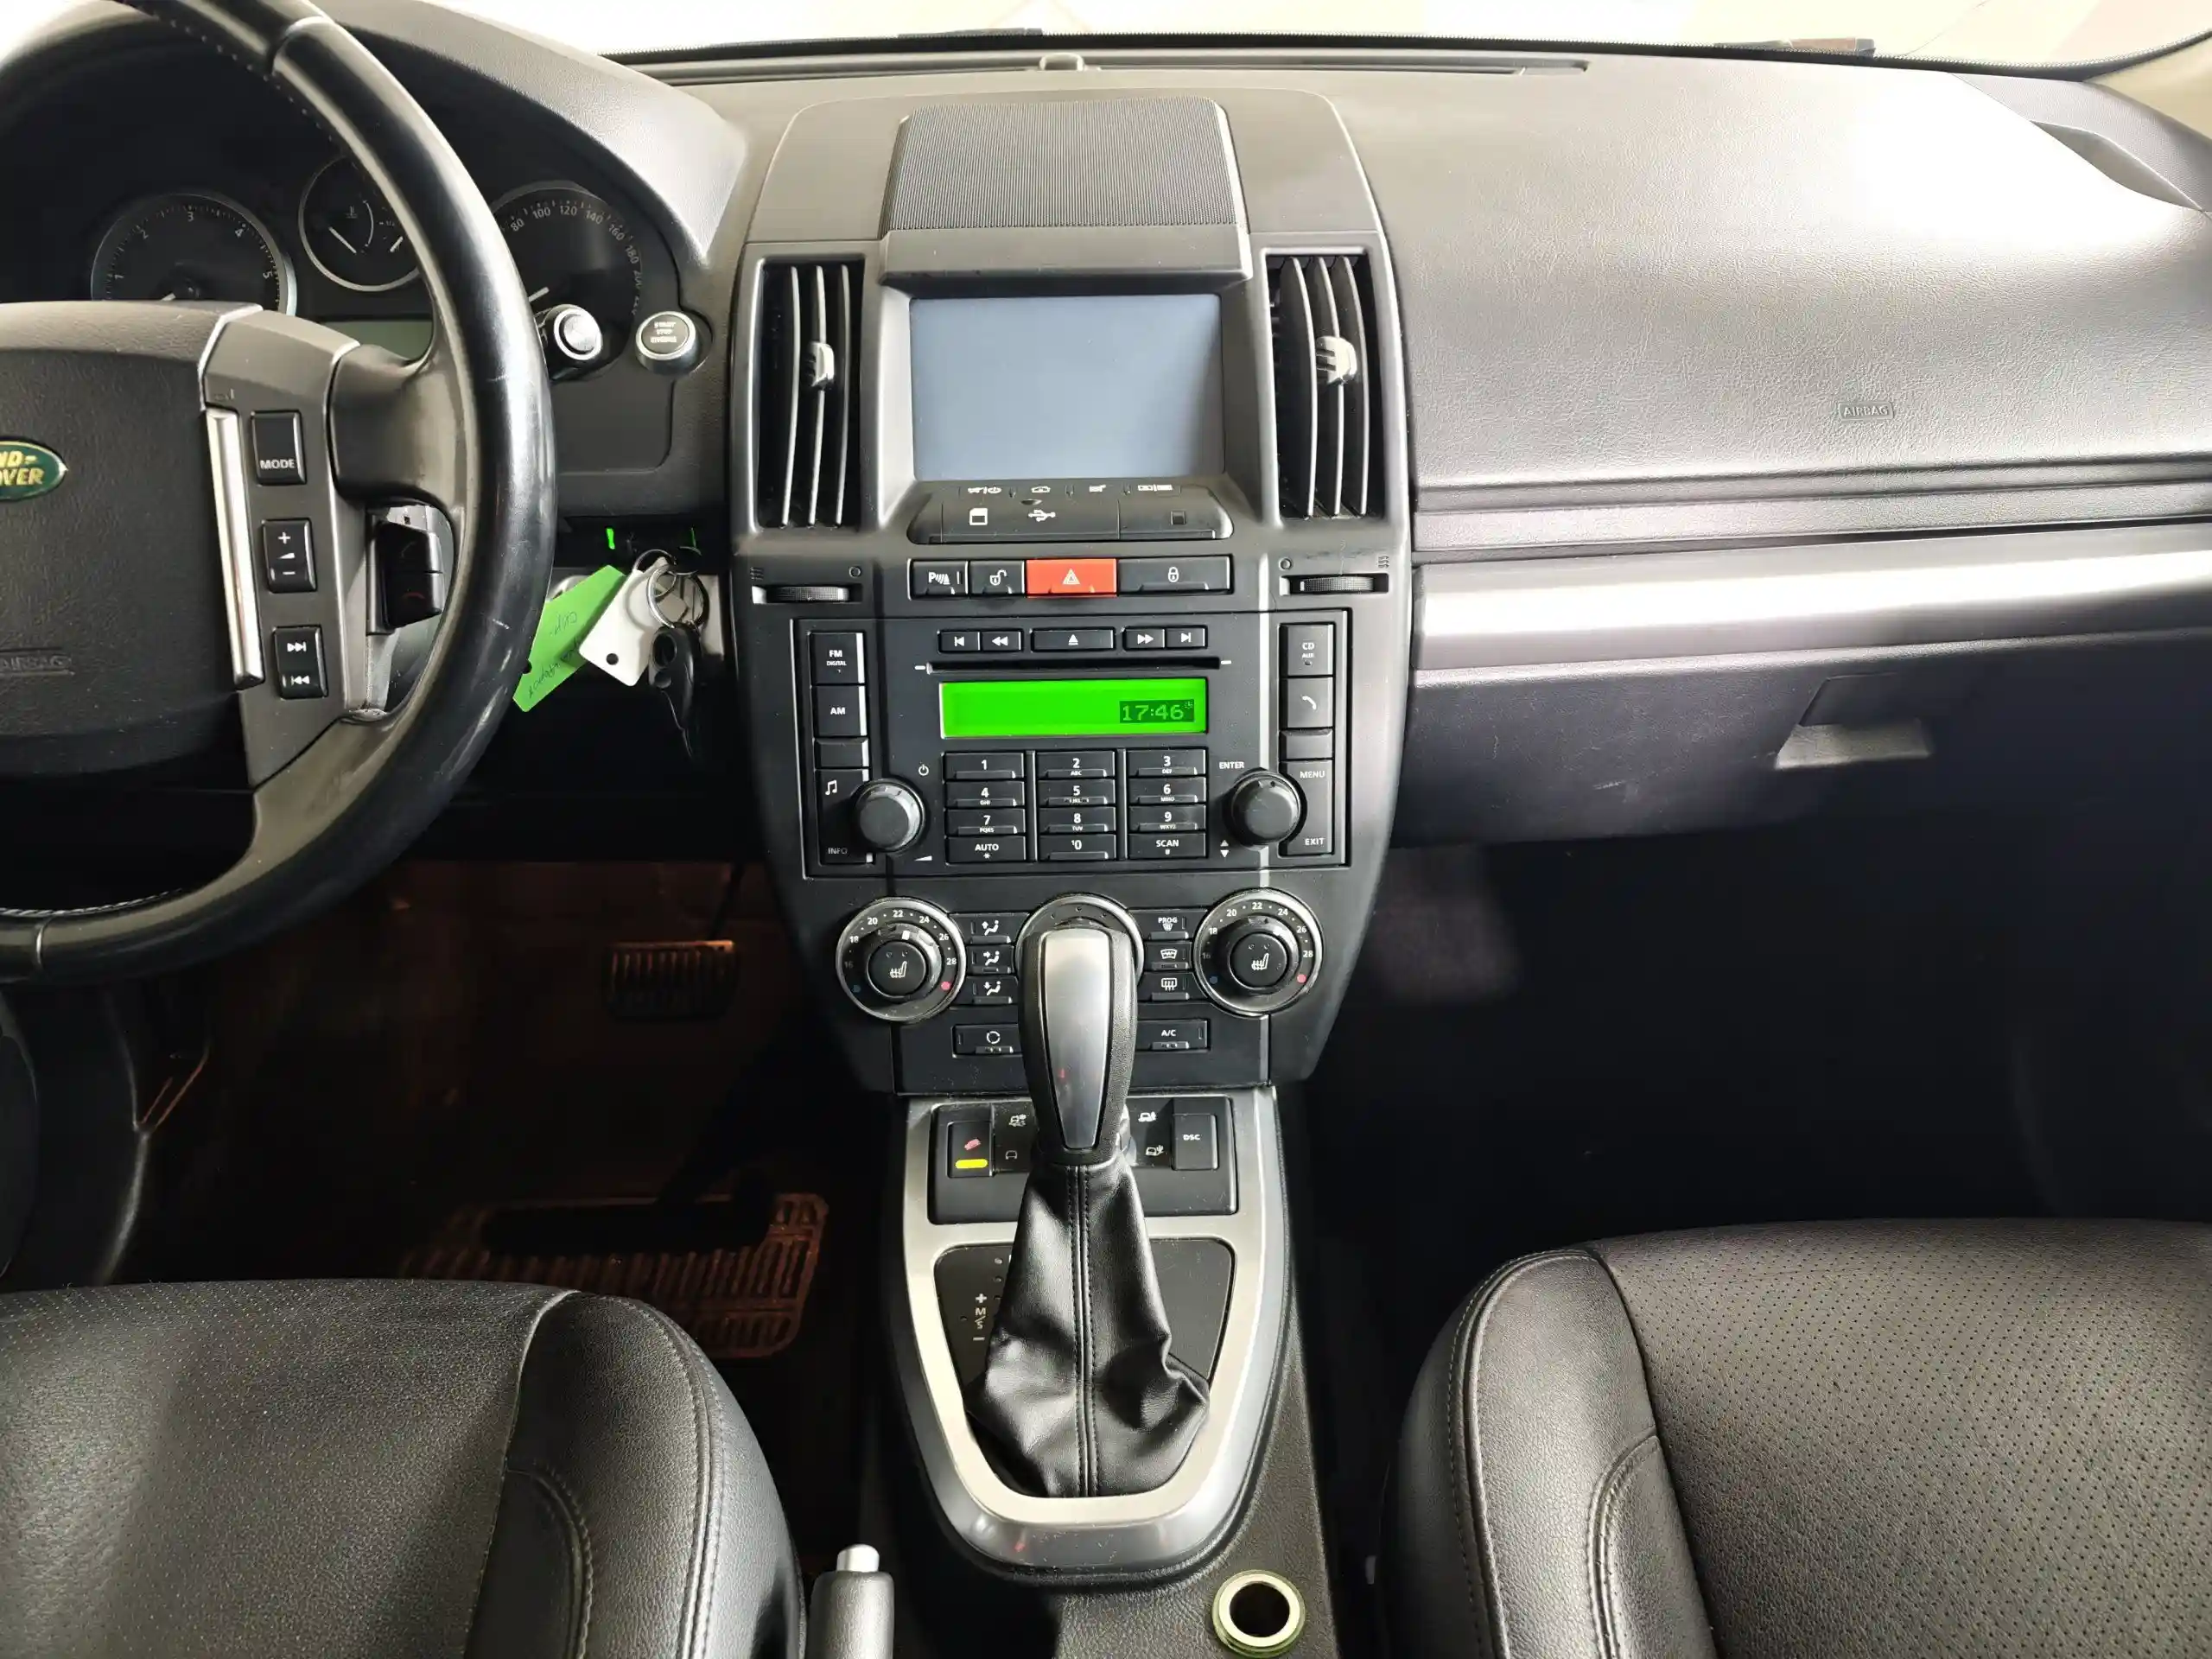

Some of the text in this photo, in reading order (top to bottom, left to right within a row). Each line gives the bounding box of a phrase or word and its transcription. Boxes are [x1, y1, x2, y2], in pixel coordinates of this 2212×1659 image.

[532, 207, 550, 219] 100
[560, 206, 577, 216] 120
[188, 212, 194, 222] 3
[586, 210, 604, 225] 140
[511, 218, 524, 232] 80
[140, 230, 149, 239] 2
[235, 228, 244, 238] 4
[608, 224, 625, 241] 160
[626, 245, 639, 264] 180
[1844, 406, 1889, 416] AIRBAG
[260, 460, 296, 469] MODE
[1122, 704, 1184, 721] 17:46
[981, 760, 988, 770] 1
[1072, 758, 1080, 768] 2
[1163, 756, 1171, 766] 3
[981, 787, 989, 798] 4
[1073, 785, 1080, 796] 5
[1163, 784, 1171, 794] 6
[983, 815, 991, 825] 7
[1073, 813, 1081, 823] 8
[1164, 811, 1172, 822] 9
